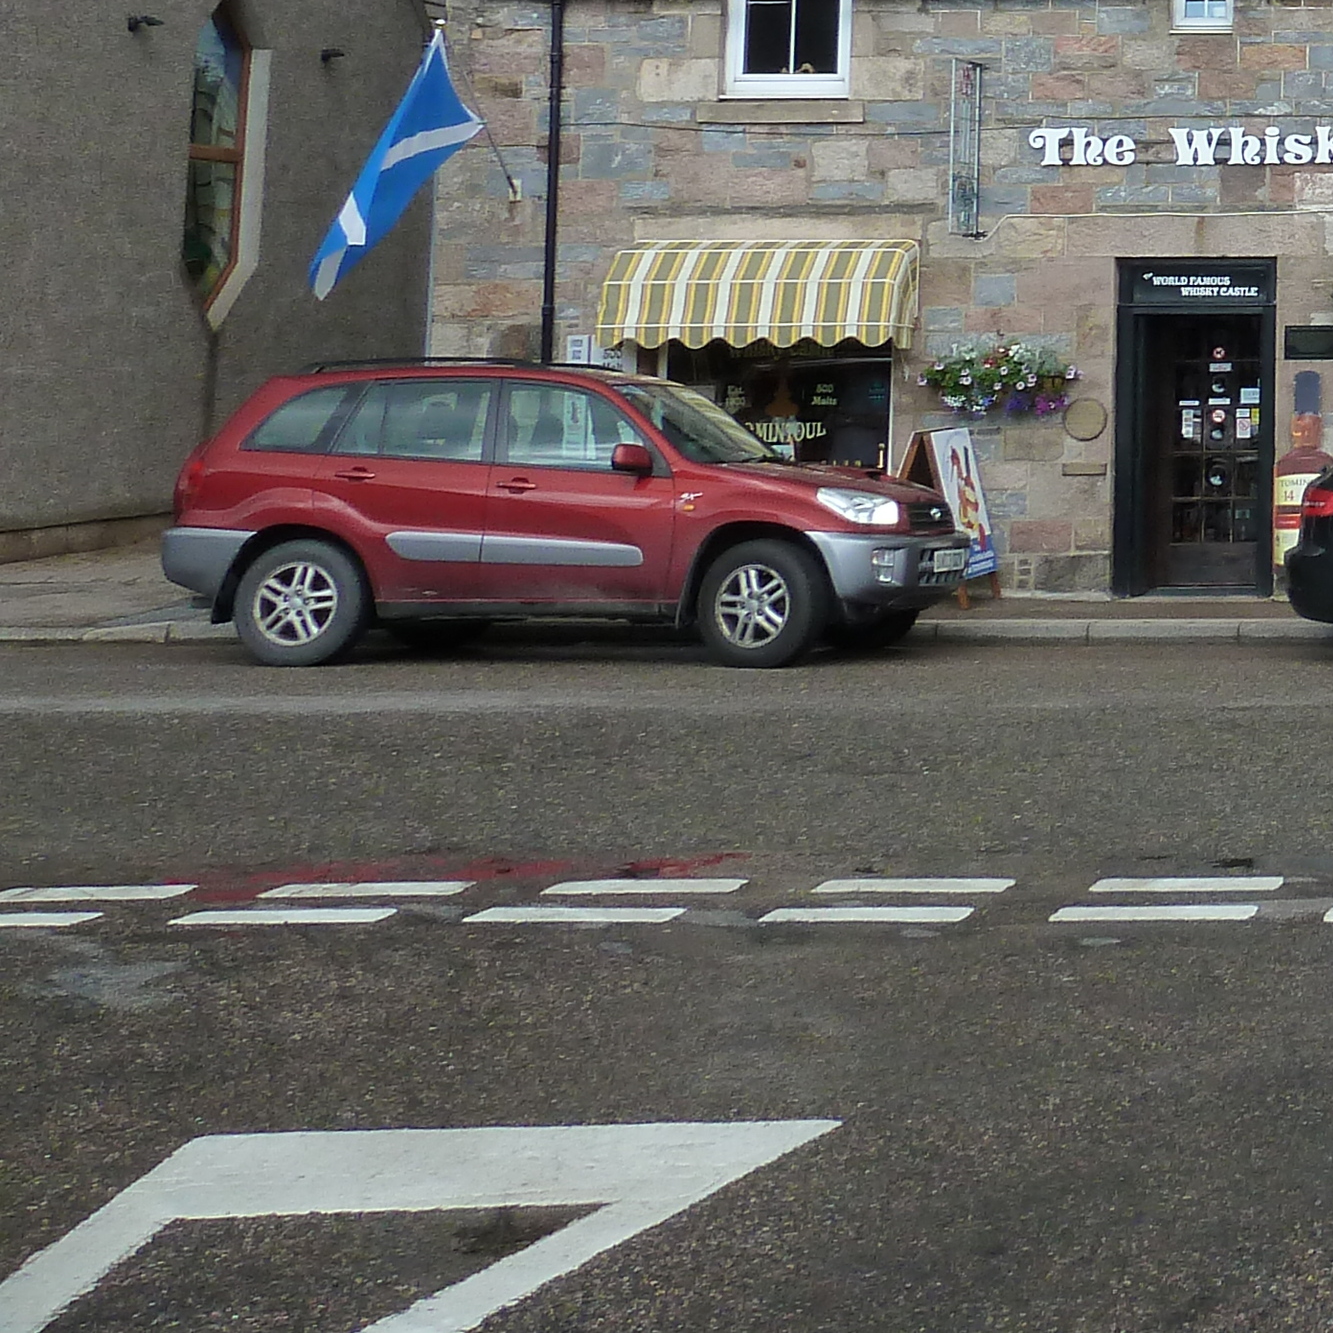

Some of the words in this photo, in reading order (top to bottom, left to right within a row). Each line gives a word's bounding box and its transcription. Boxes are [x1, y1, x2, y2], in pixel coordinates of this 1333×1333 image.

[1029, 127, 1136, 166] The
[1153, 277, 1188, 285] WORLD
[1189, 276, 1230, 285] FAMOUS
[1181, 287, 1219, 296] WHISKY
[1220, 287, 1258, 296] CASTLE
[816, 383, 834, 394] 500
[811, 395, 838, 406] Malts
[1283, 490, 1295, 501] 14
